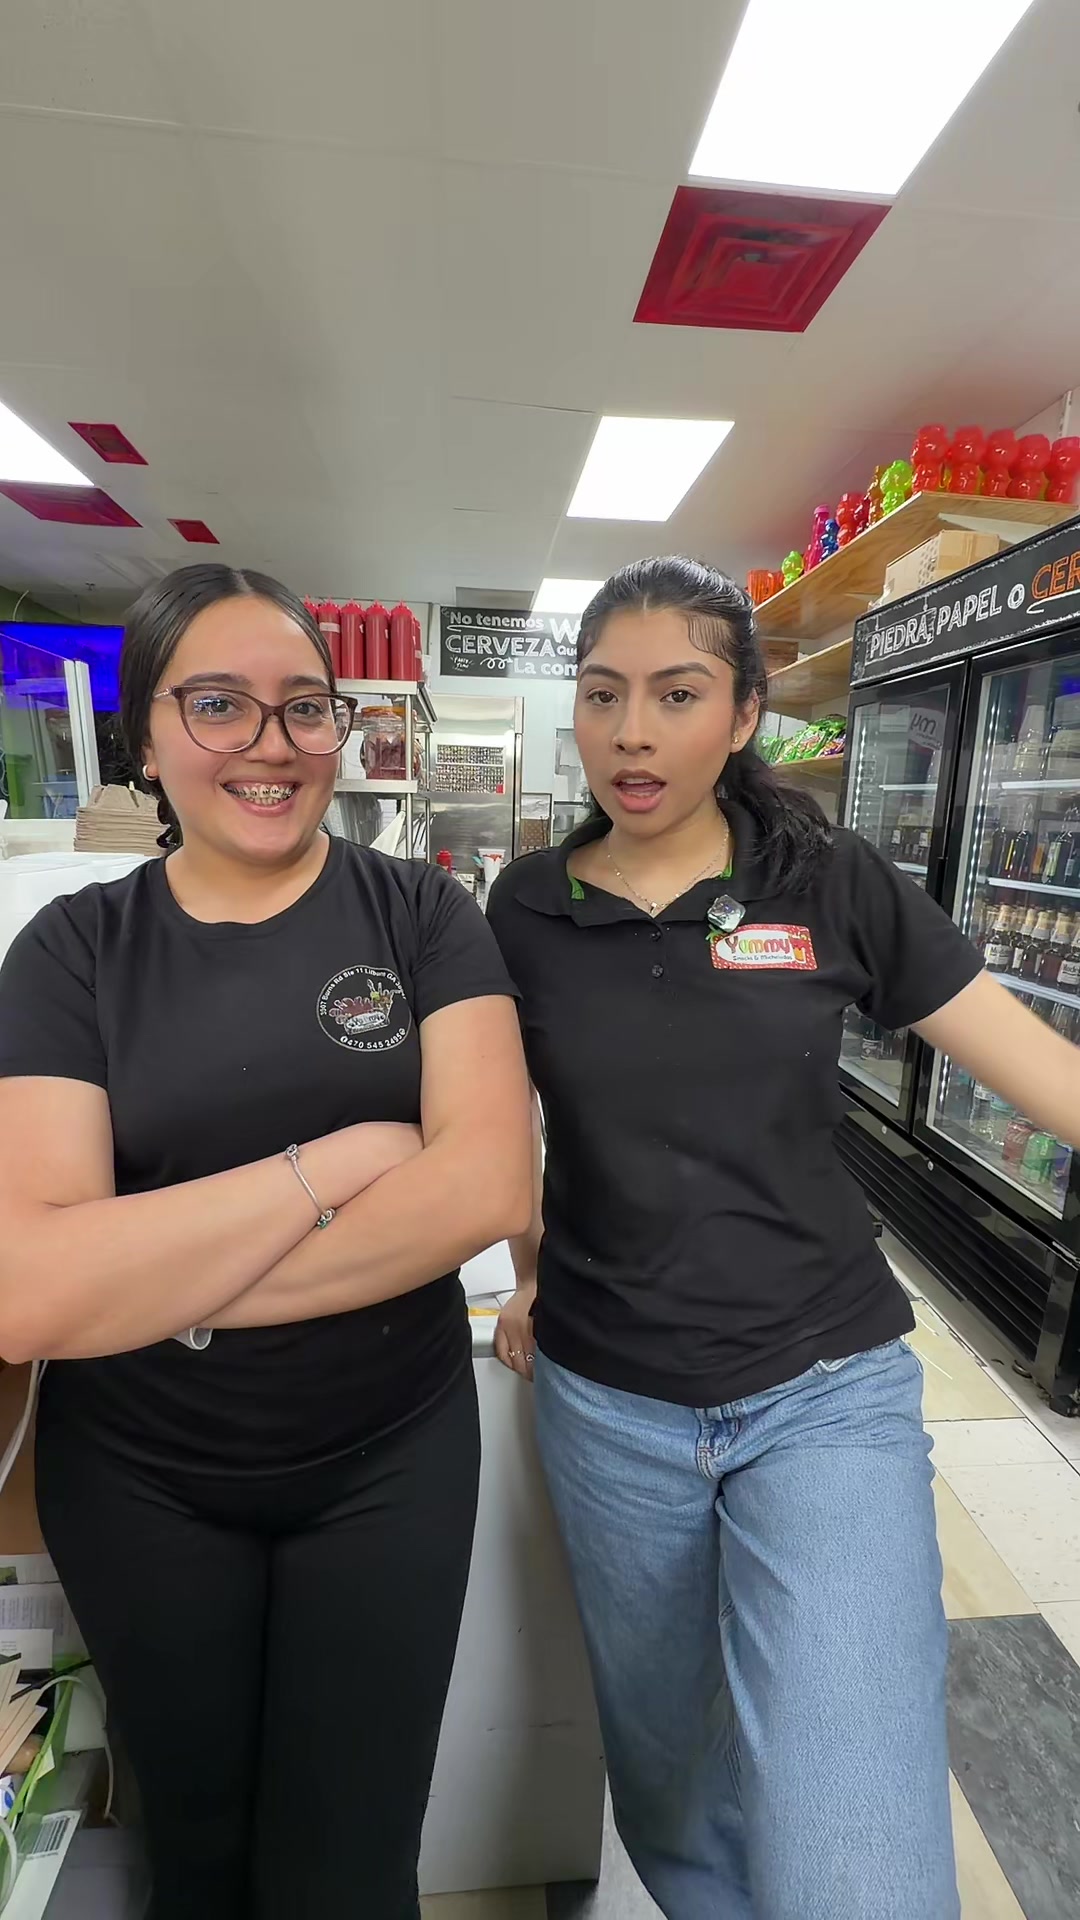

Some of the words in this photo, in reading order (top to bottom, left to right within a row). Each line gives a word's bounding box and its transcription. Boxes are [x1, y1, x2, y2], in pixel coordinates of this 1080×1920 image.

[936, 584, 1002, 636] PAPEL
[450, 611, 472, 625] No
[475, 613, 545, 629] tenemos
[445, 634, 556, 658] CERVEZA
[513, 658, 536, 674] La
[725, 935, 791, 954] Yummy
